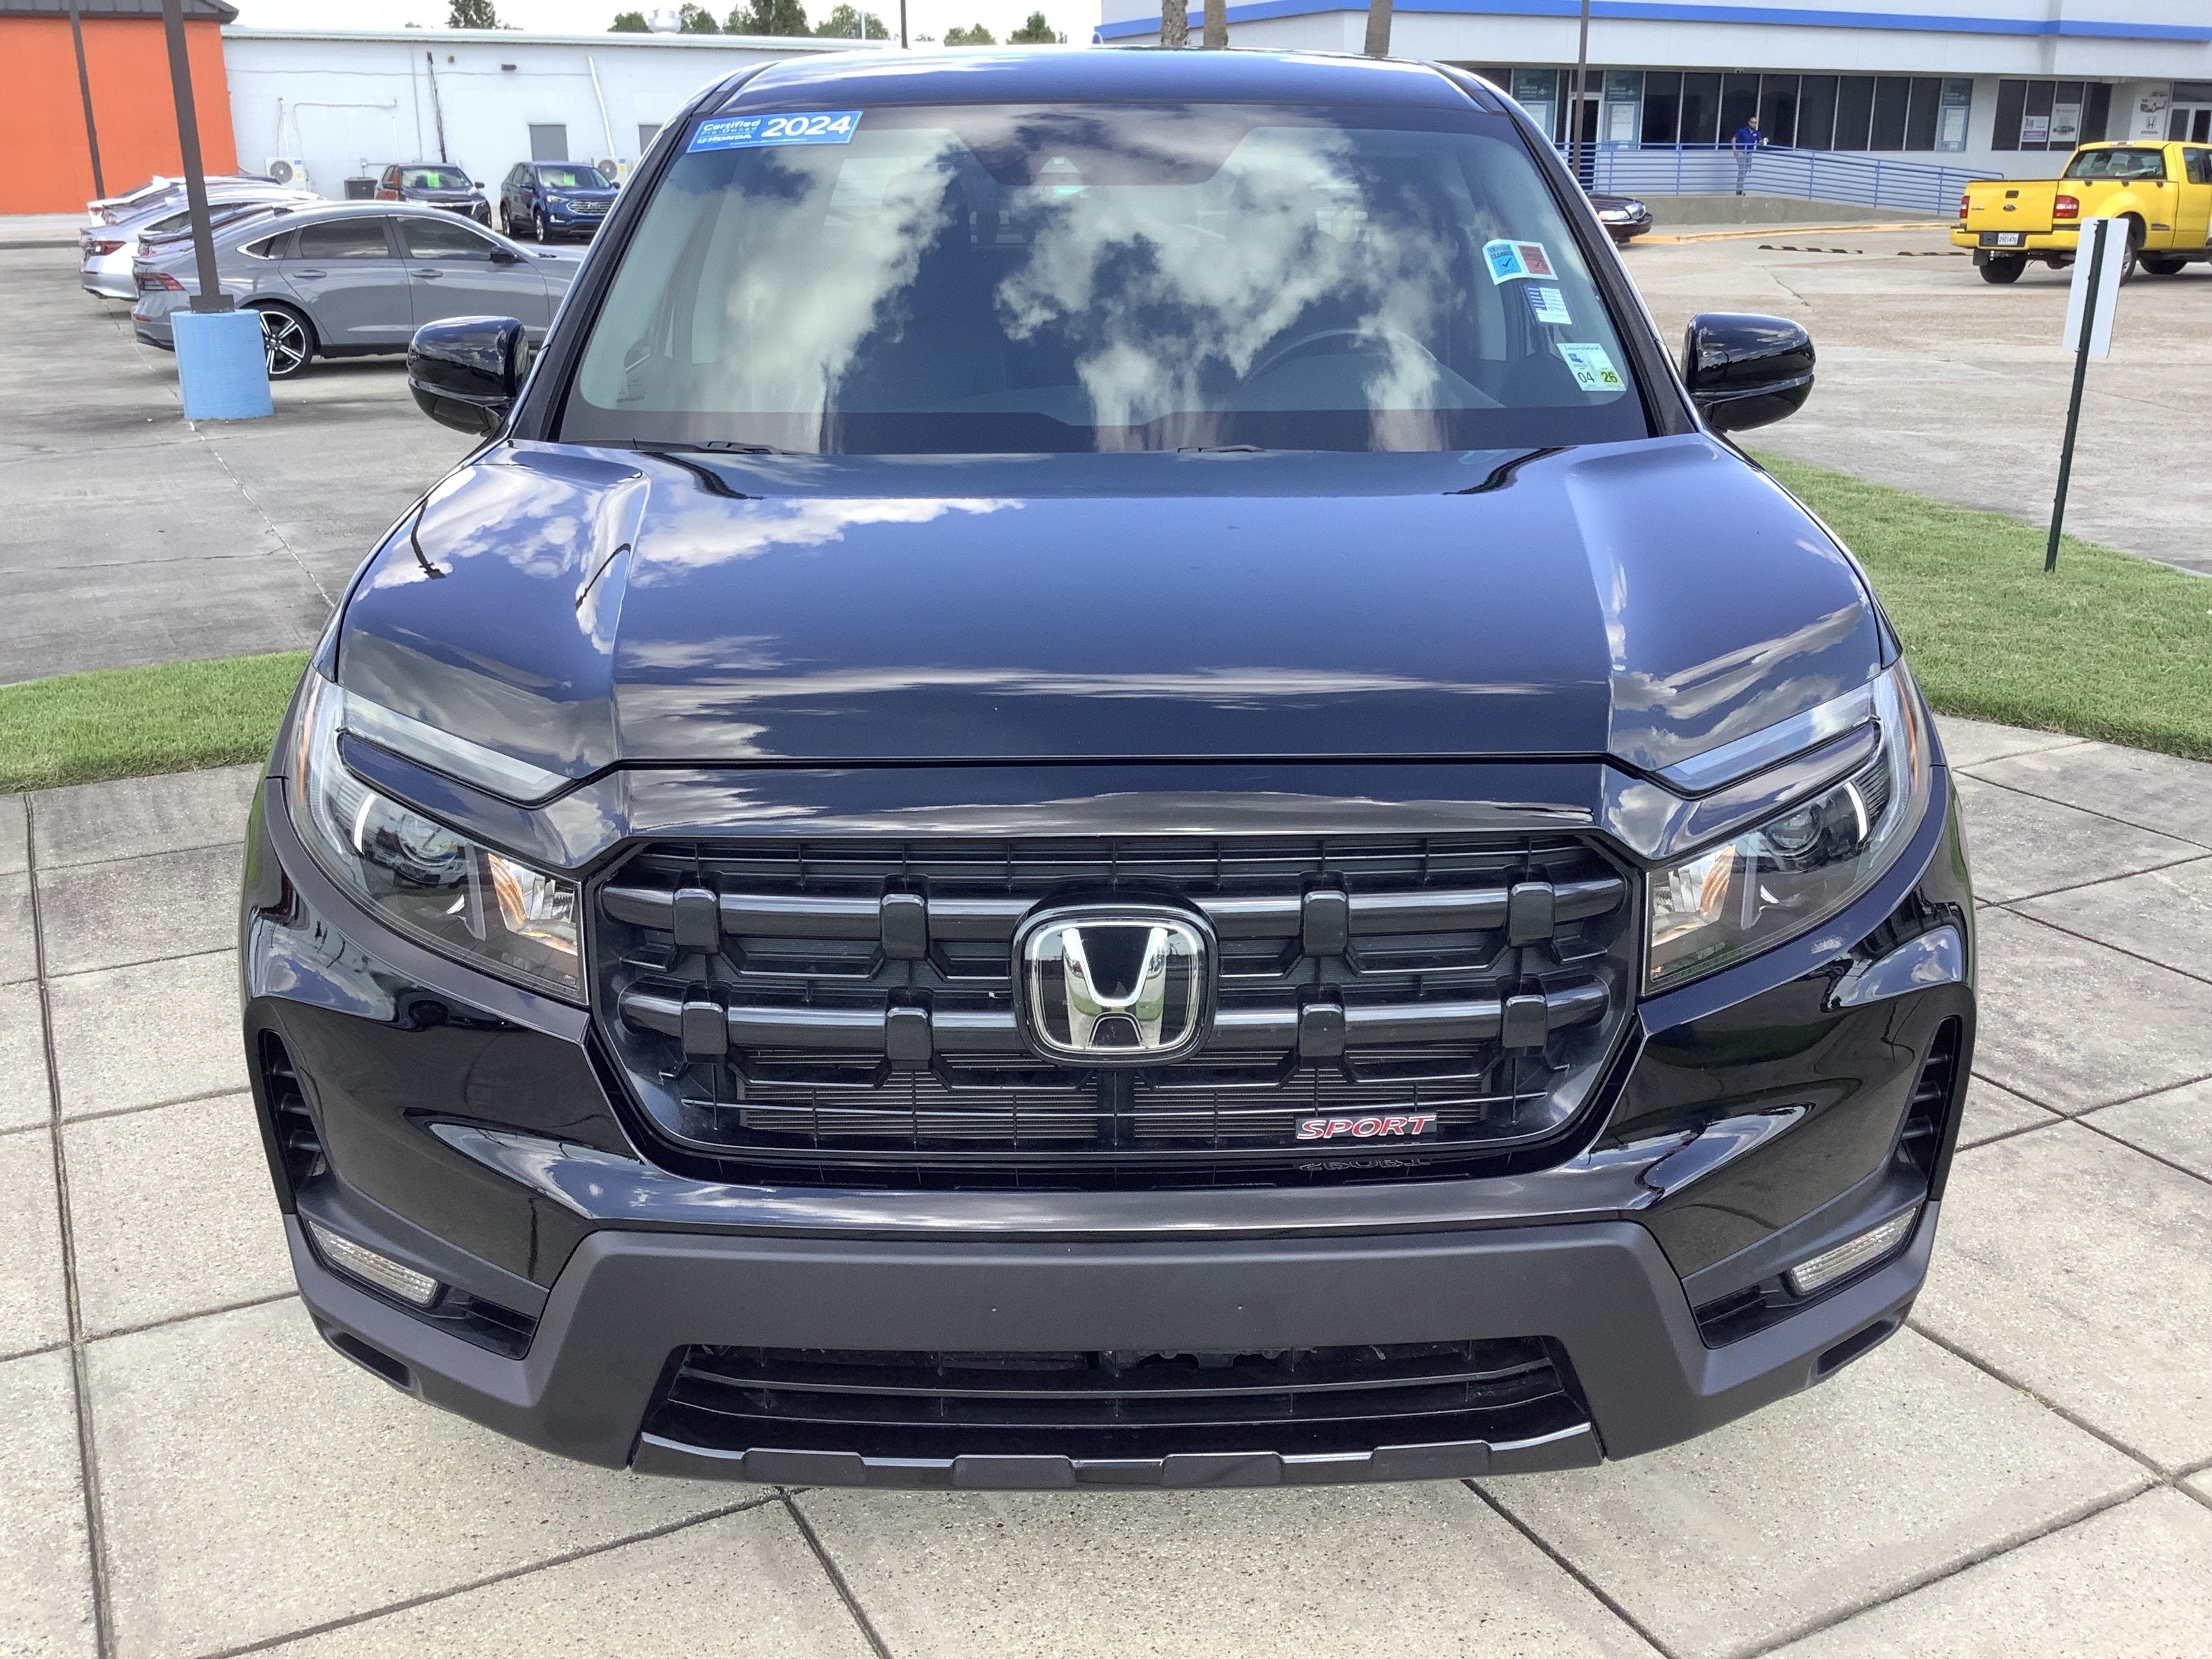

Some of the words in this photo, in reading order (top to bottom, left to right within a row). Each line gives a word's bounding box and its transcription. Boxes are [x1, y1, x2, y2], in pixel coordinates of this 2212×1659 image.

[703, 119, 761, 131] Certified
[761, 115, 851, 138] 2024
[1578, 371, 1595, 384] 04
[1601, 371, 1618, 384] 26
[1296, 1115, 1437, 1140] SPORT
